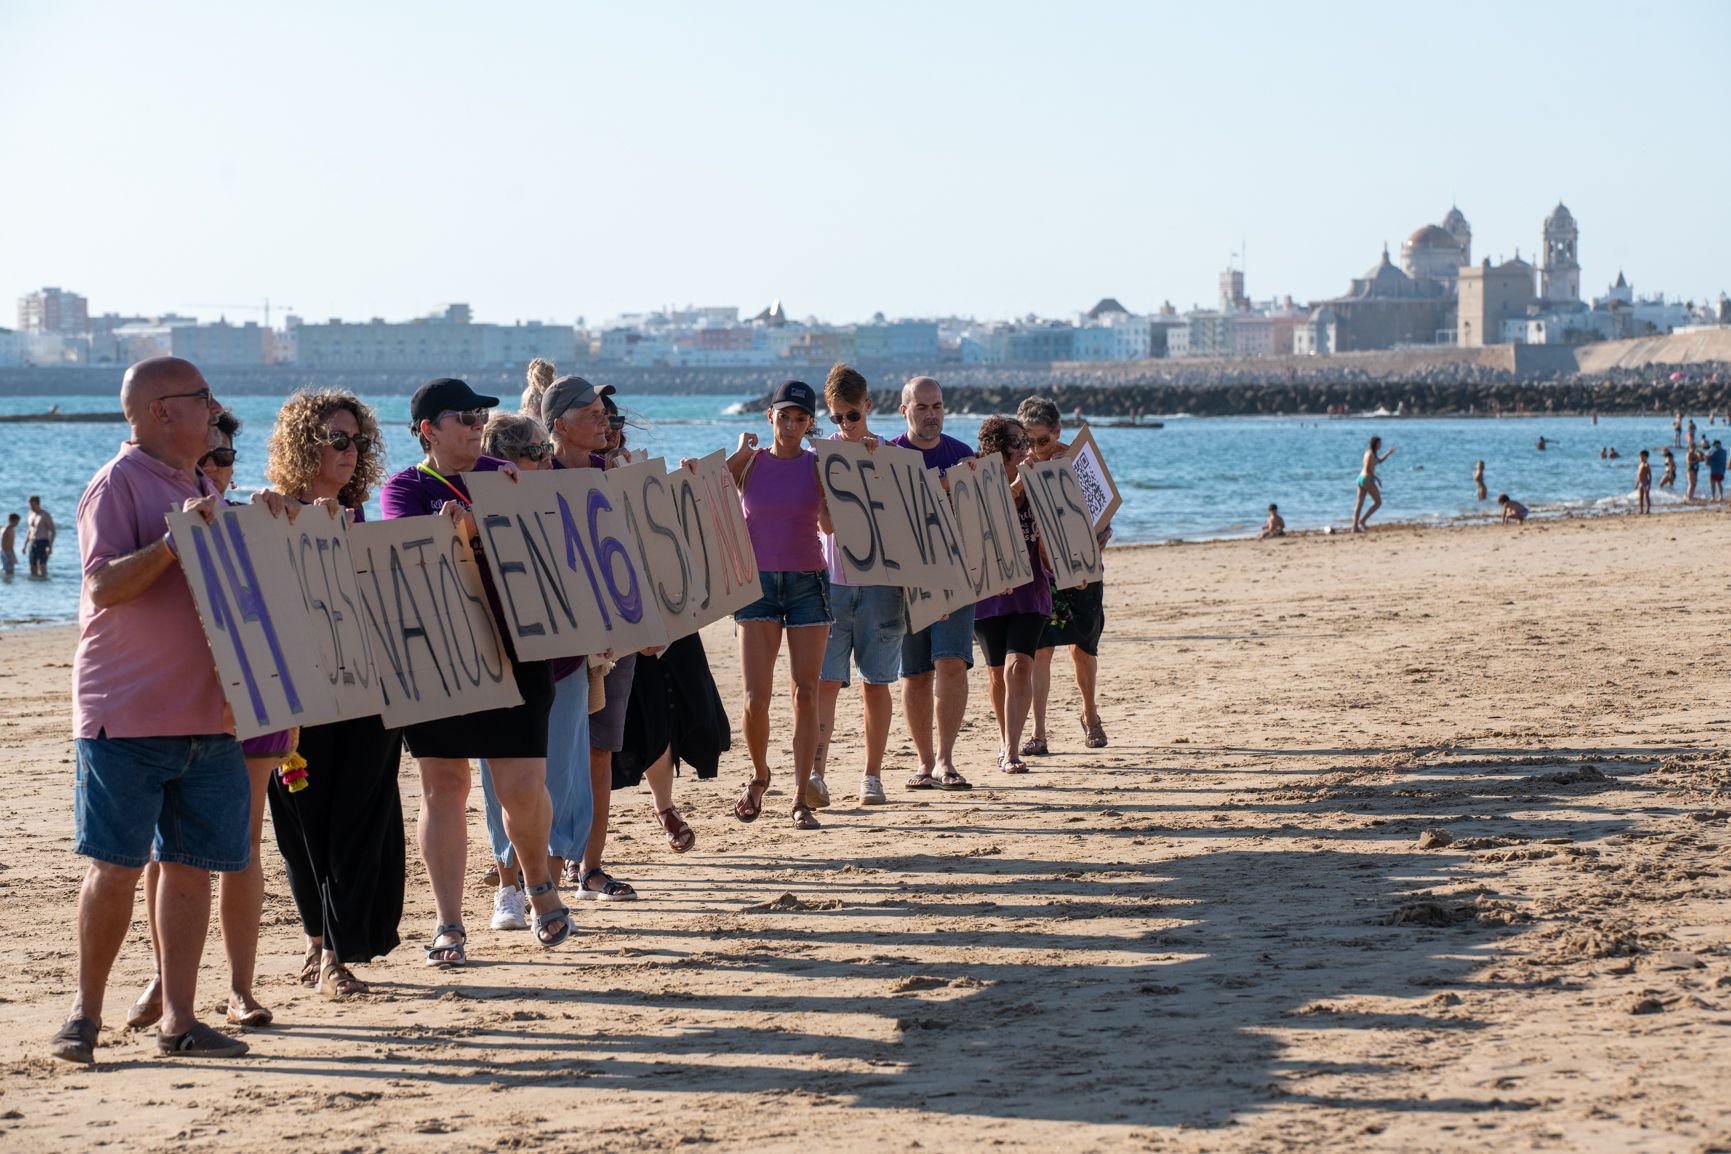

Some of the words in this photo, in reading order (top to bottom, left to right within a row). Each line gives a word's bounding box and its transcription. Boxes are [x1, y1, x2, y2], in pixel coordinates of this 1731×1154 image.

[483, 511, 578, 638] EN
[556, 488, 643, 632] 16
[702, 466, 753, 596] NO
[825, 453, 901, 572] SE
[191, 511, 303, 727] 14
